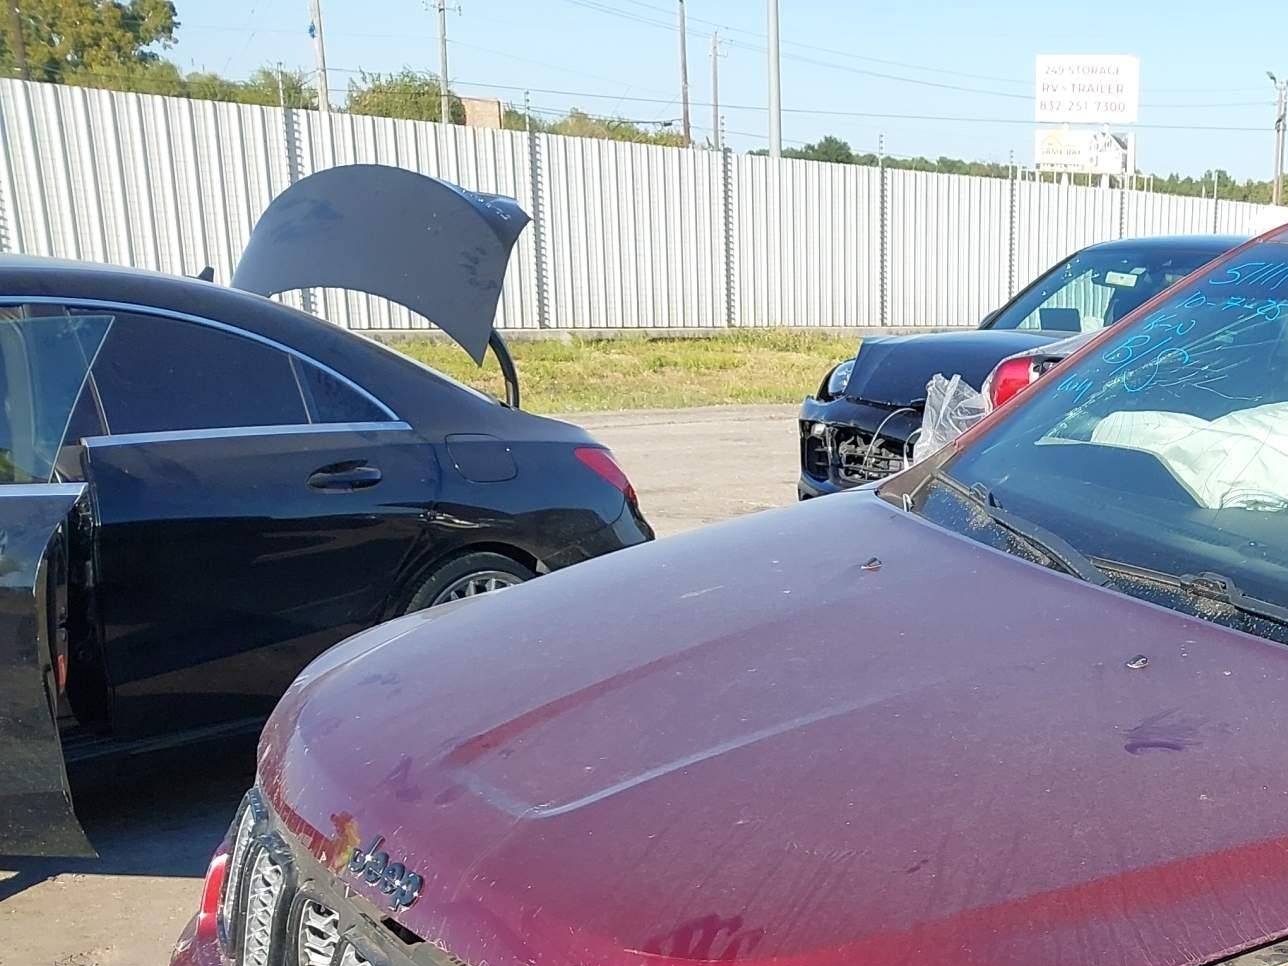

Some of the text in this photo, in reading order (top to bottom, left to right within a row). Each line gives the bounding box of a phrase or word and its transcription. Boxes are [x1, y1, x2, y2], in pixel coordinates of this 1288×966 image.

[1068, 64, 1120, 76] STORAGE
[1042, 82, 1057, 94] RV
[1071, 82, 1125, 94] TRAILER
[348, 835, 425, 913] Jeep
